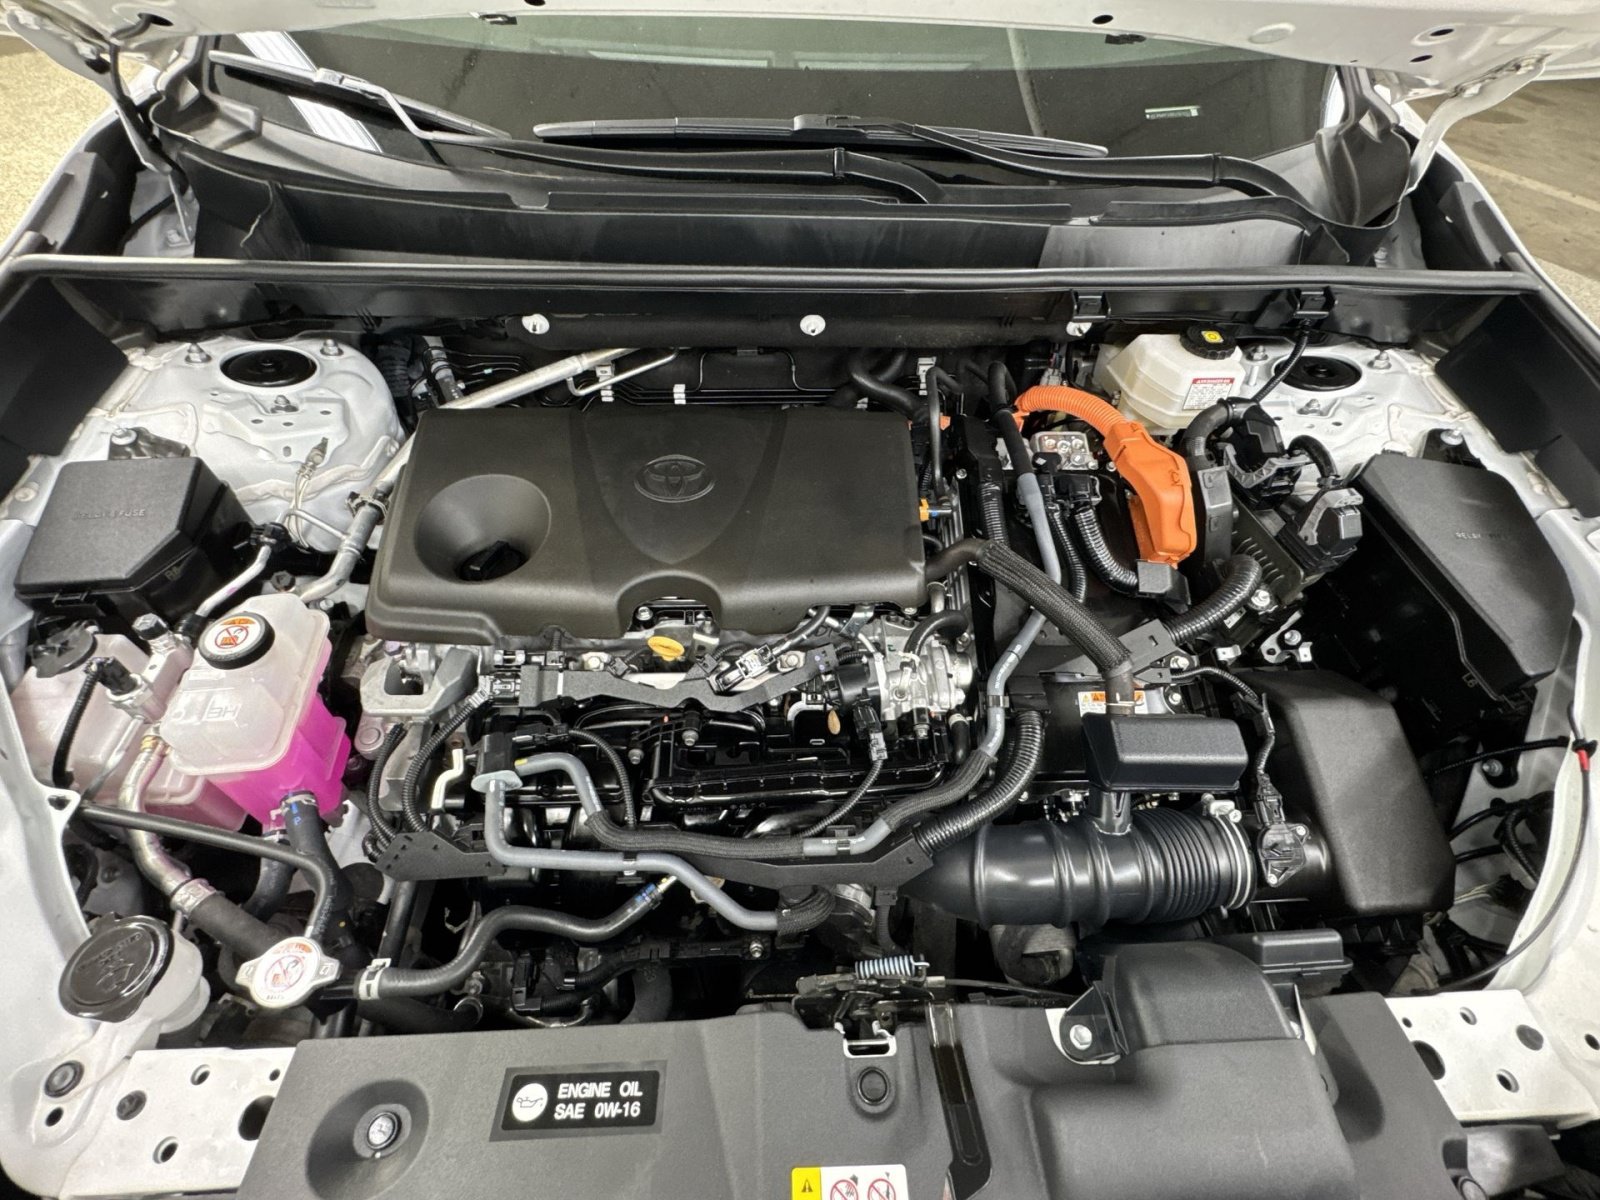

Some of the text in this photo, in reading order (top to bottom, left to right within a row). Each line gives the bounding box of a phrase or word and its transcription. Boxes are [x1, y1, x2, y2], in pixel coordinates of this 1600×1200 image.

[557, 1080, 643, 1099] ENGINE OIL
[554, 1101, 641, 1120] SAE 0W-16
